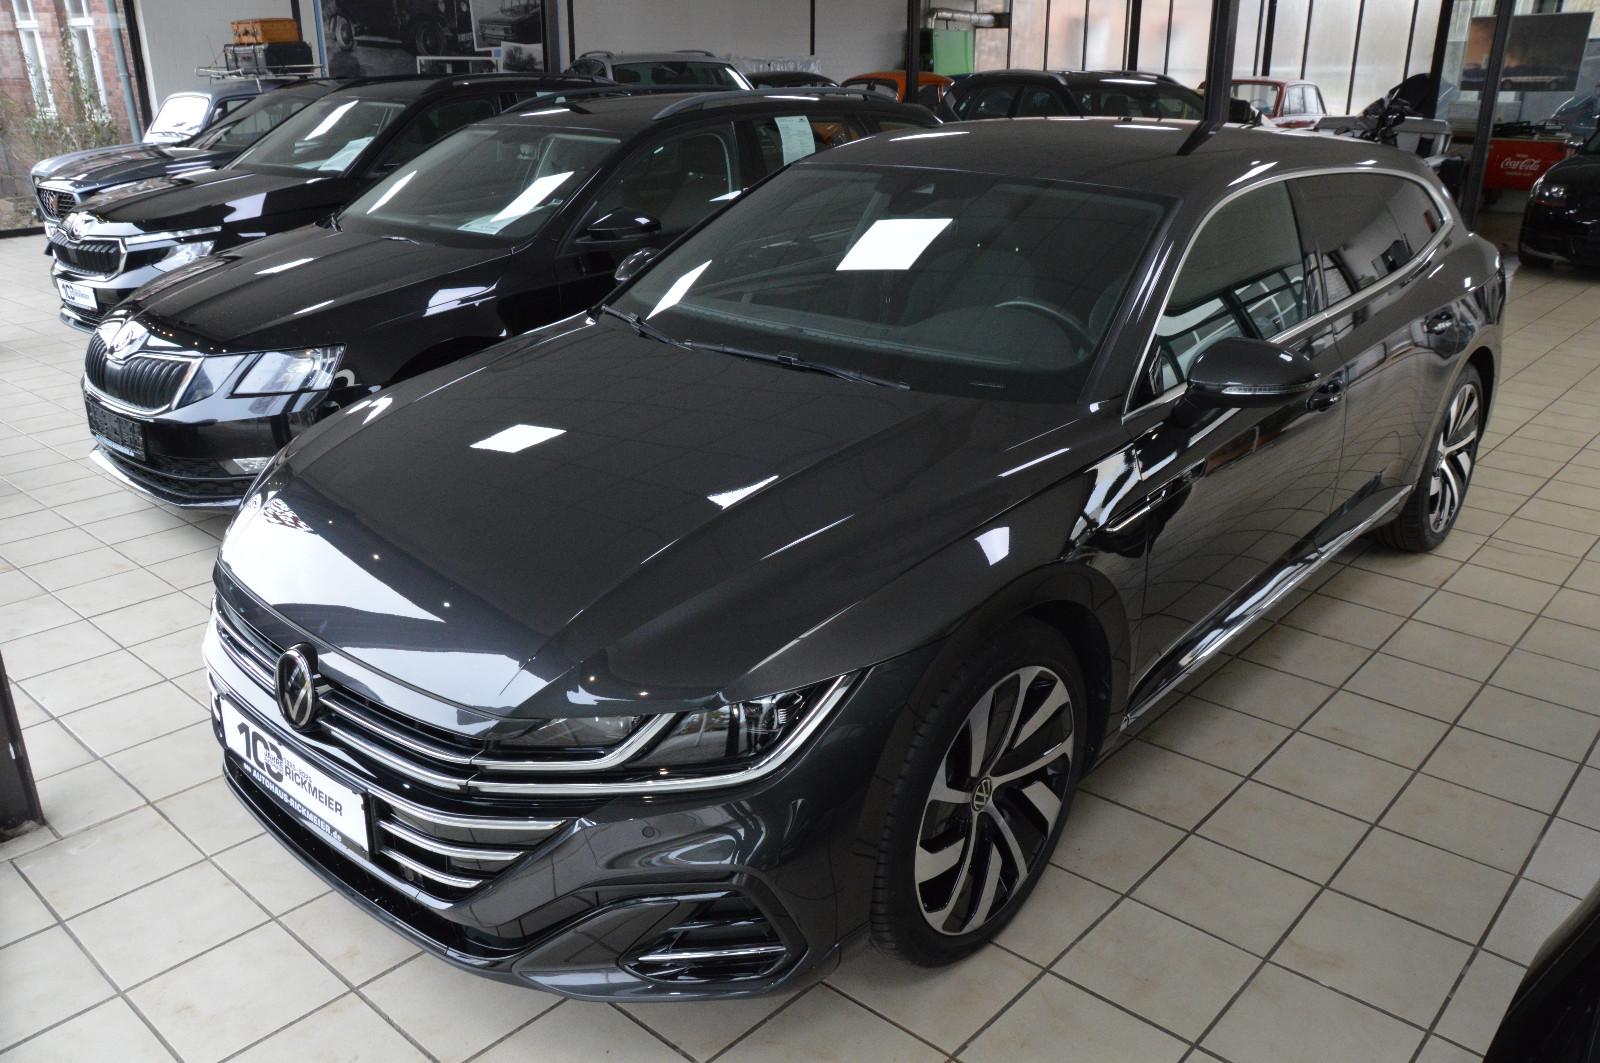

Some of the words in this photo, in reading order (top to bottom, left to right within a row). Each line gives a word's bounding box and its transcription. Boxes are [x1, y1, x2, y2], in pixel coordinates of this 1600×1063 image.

[1500, 157, 1541, 171] Coca-Cola
[237, 722, 284, 783] 100
[252, 769, 342, 842] AUTOHAUS-RICKMEIER.de
[284, 765, 343, 817] RICKMEIER
